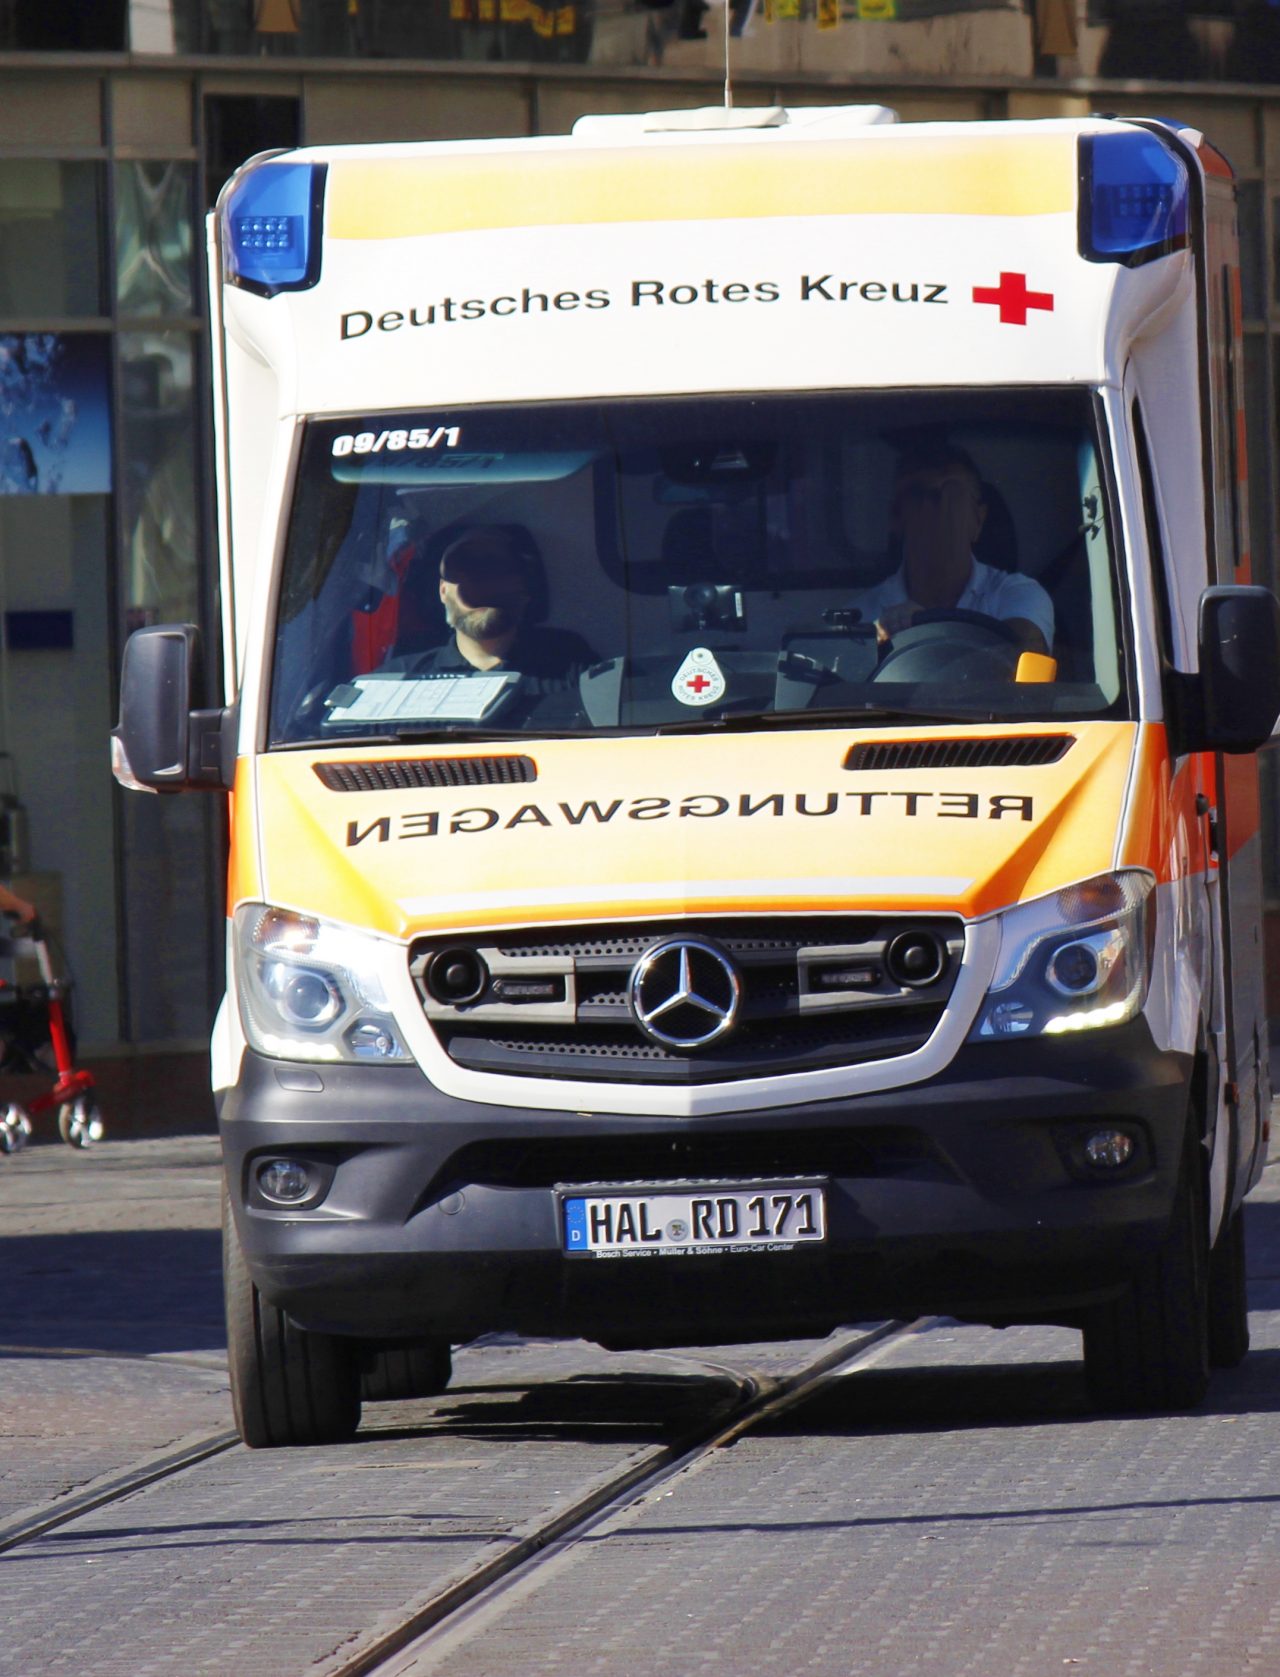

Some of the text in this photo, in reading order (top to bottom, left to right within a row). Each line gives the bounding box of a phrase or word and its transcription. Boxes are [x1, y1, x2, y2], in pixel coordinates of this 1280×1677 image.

[340, 274, 949, 340] Deutsches Rotes Kreuz
[332, 427, 460, 456] 09/85/1
[571, 1194, 817, 1243] D HAL RD 171
[596, 1250, 621, 1258] Bosch
[623, 1249, 652, 1257] Service
[767, 1242, 794, 1252] Center
